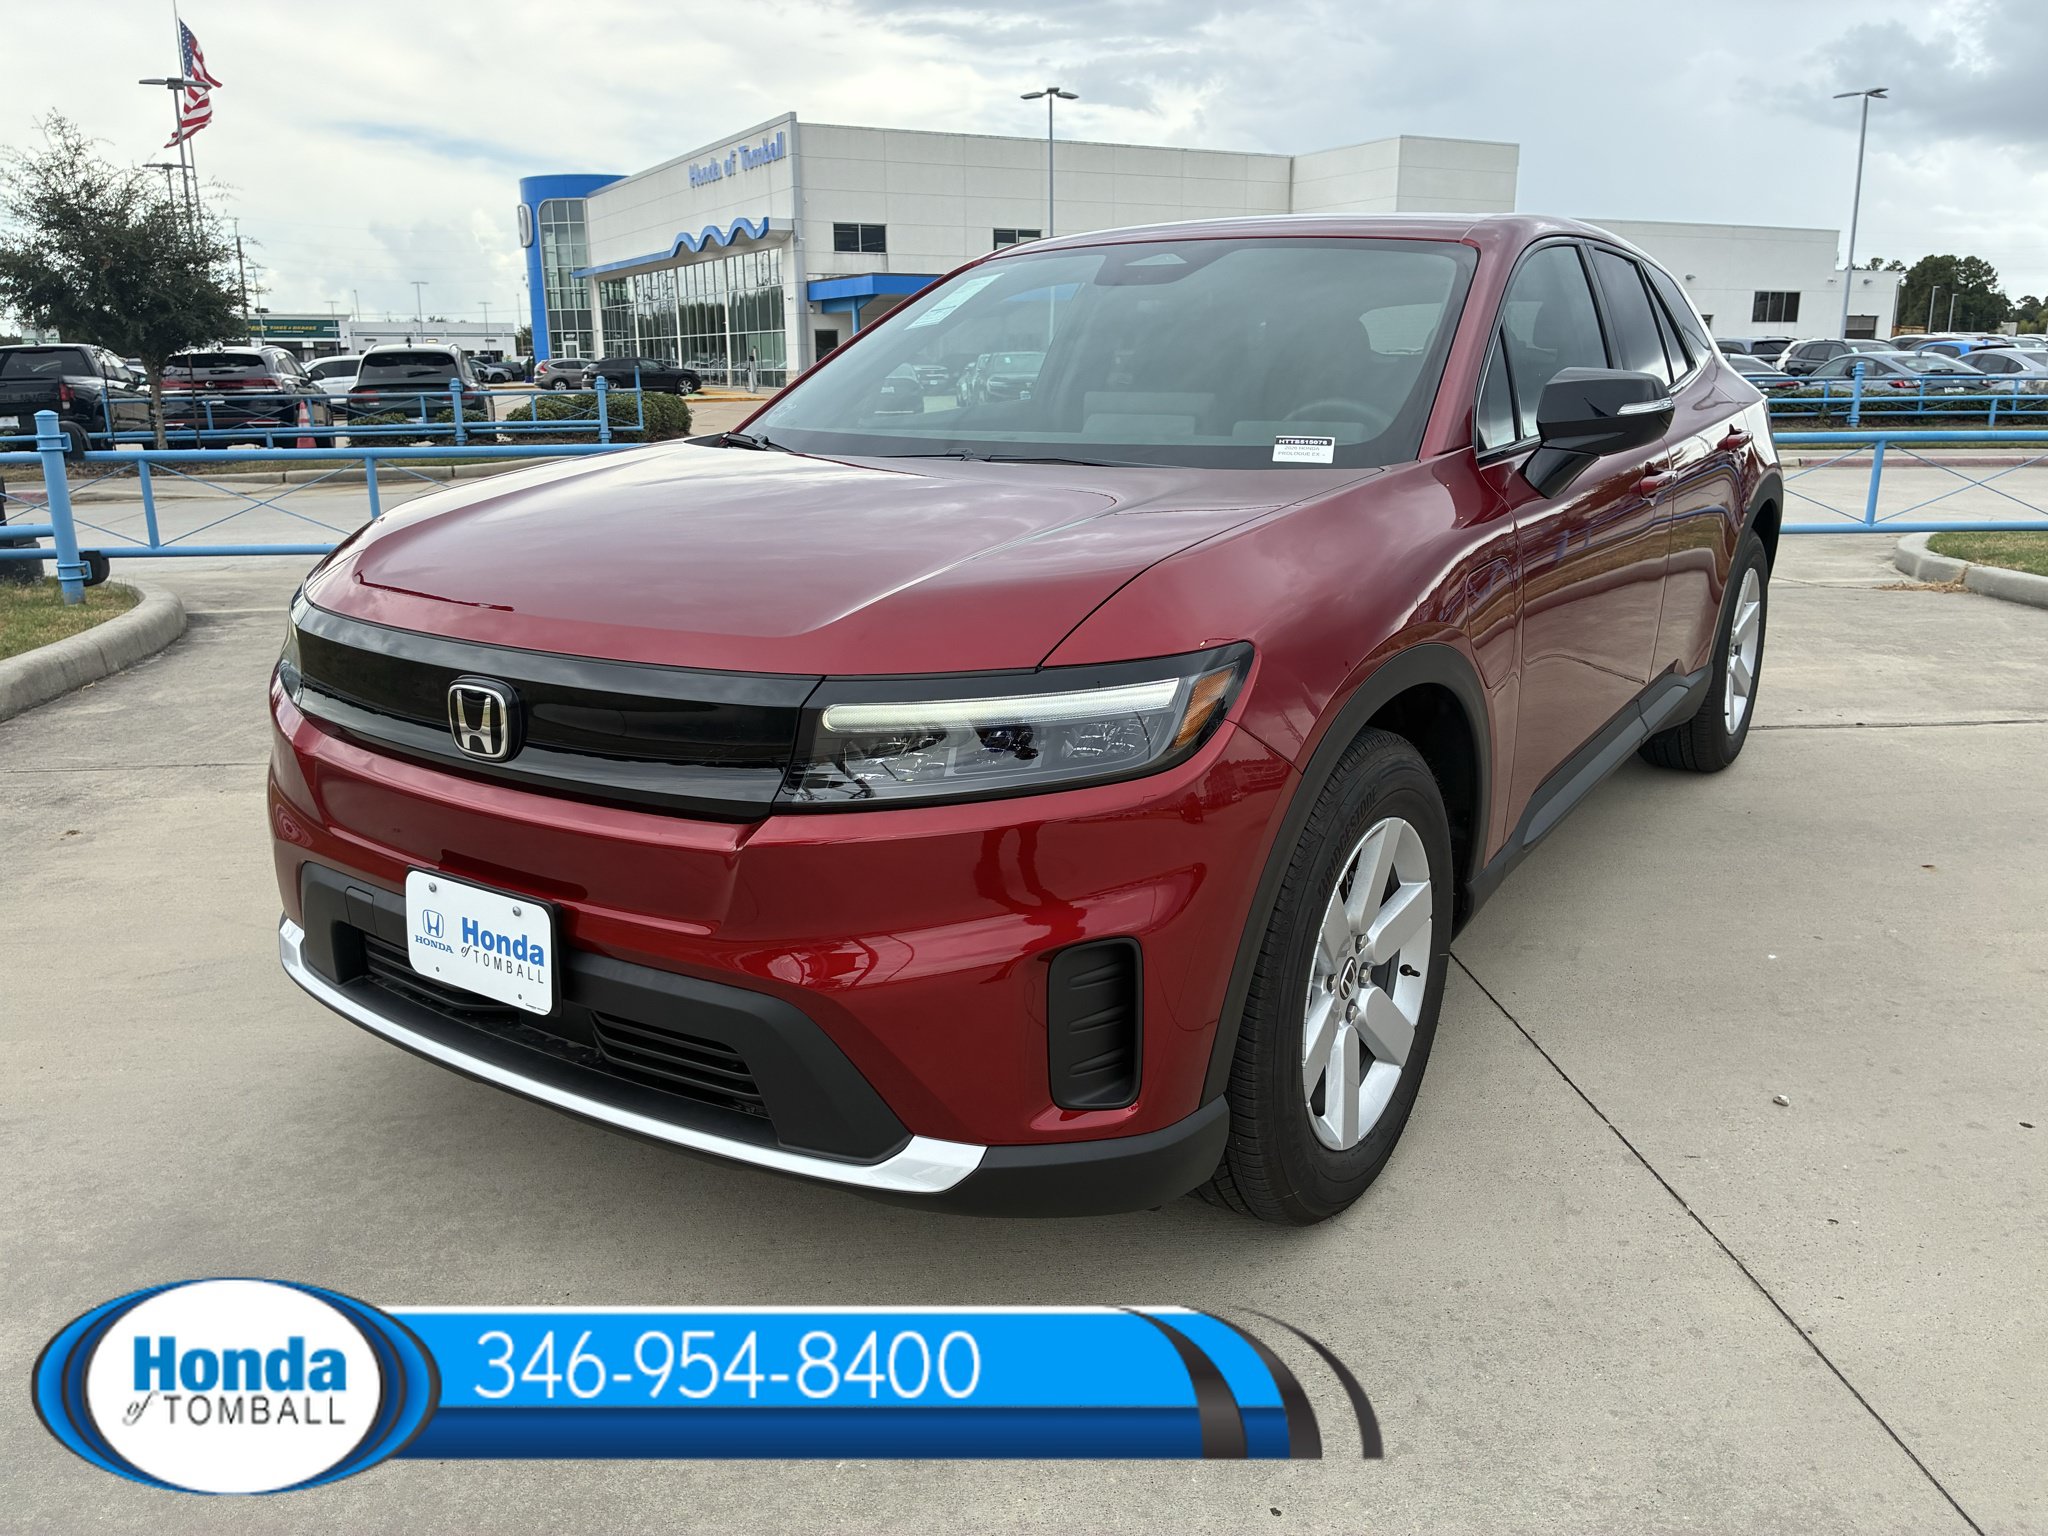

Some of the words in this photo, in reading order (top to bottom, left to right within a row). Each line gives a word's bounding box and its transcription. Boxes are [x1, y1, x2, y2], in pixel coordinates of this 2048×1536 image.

[688, 157, 722, 188] Honda
[724, 151, 737, 176] of
[738, 131, 785, 171] Tomball
[414, 934, 454, 954] HONDA
[460, 944, 473, 957] of
[473, 949, 544, 984] TOMBALL
[461, 916, 545, 967] Honda
